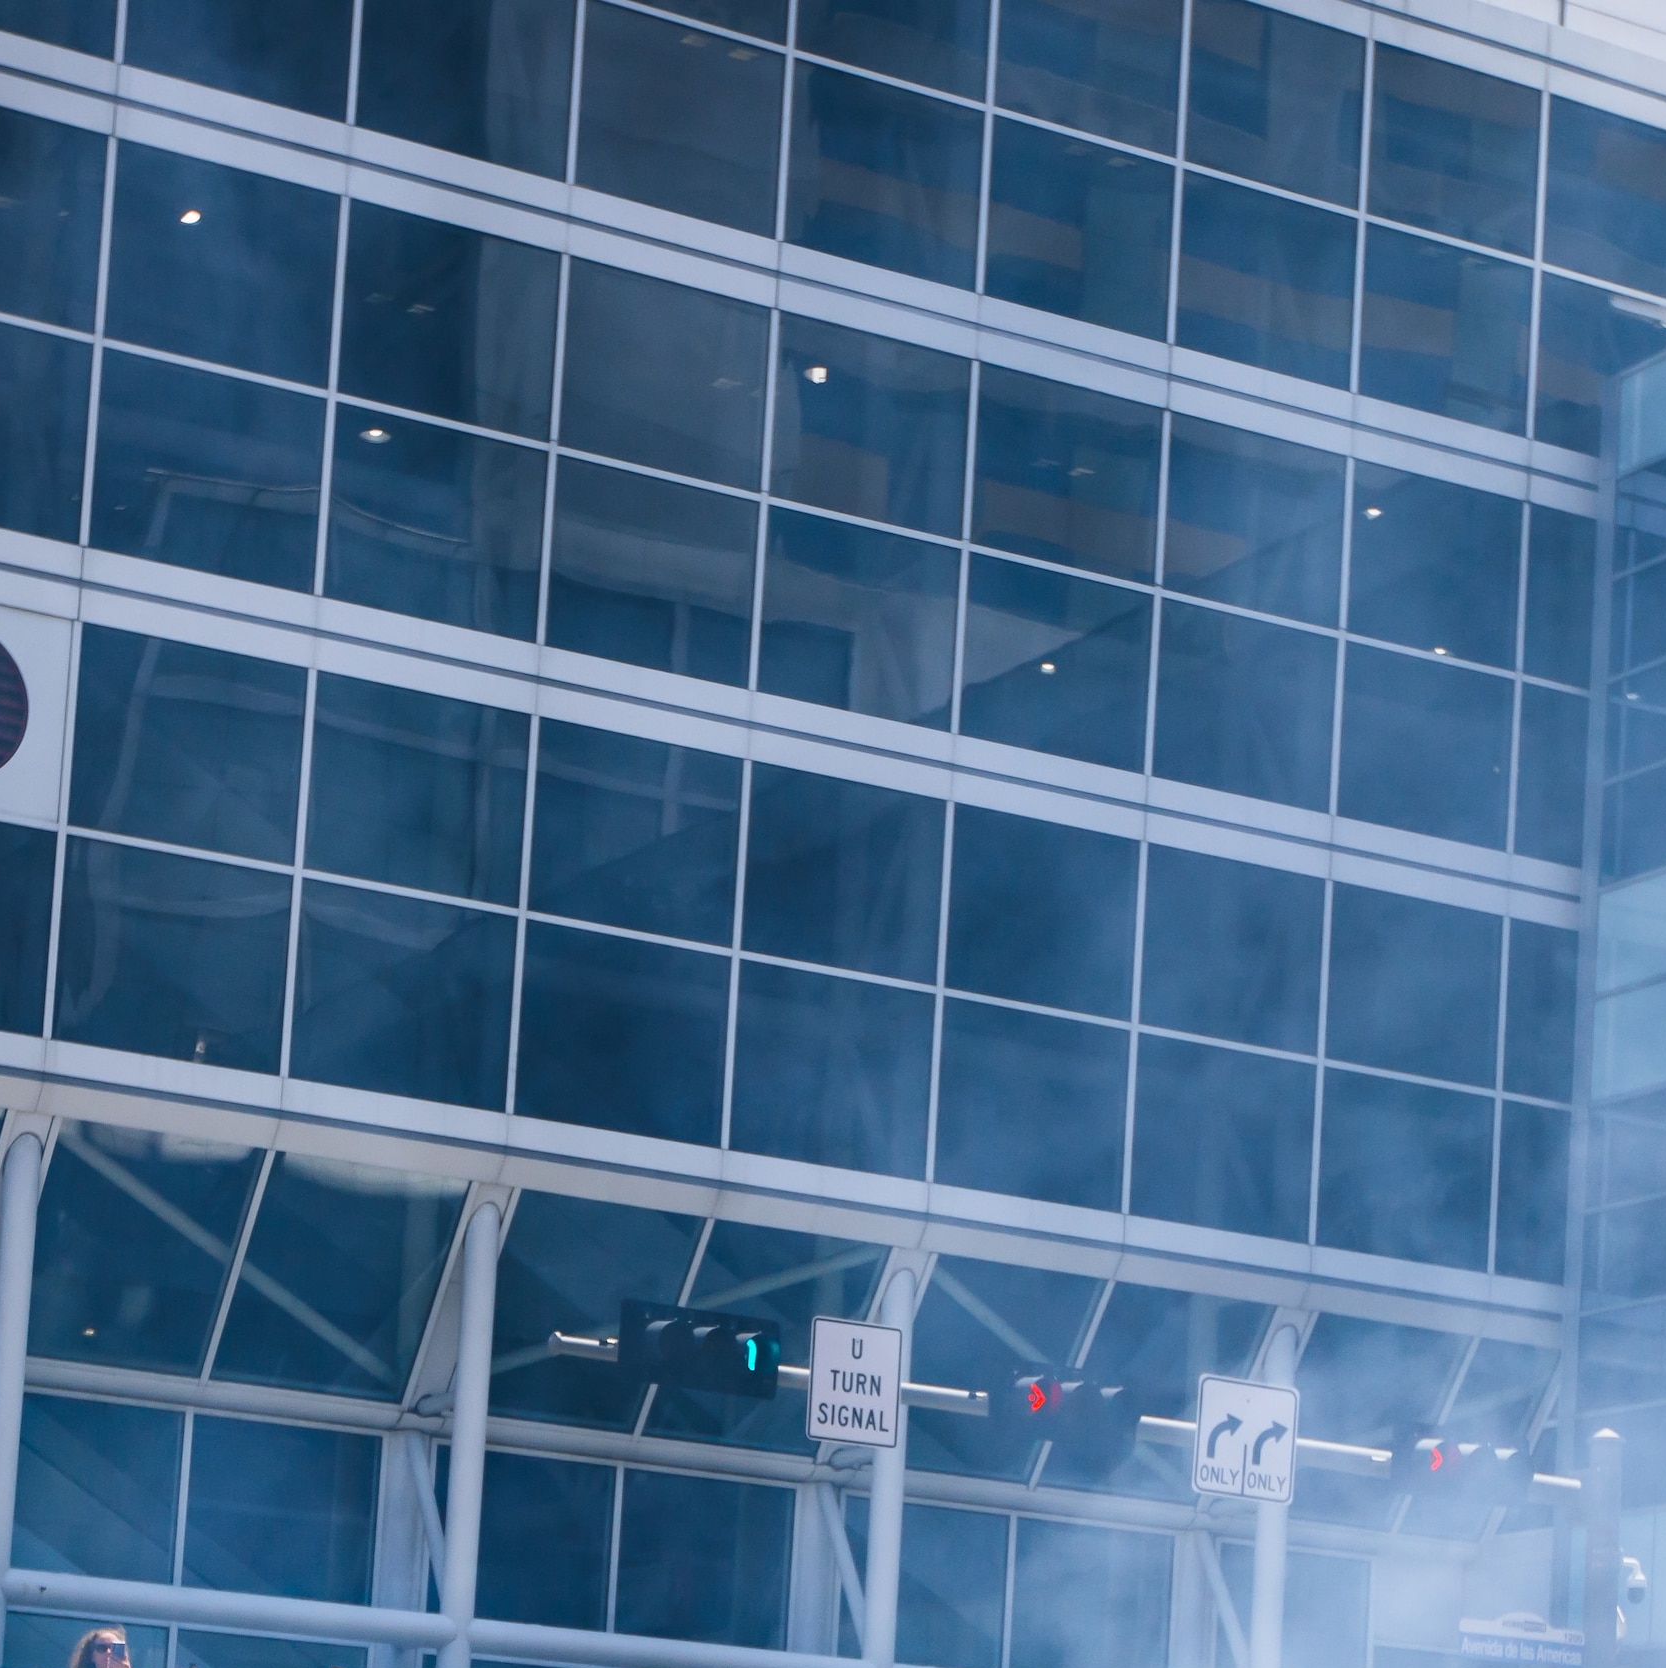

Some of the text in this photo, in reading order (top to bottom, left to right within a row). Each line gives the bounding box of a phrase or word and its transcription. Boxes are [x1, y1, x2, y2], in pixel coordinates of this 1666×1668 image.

[851, 1338, 863, 1360] U
[830, 1369, 882, 1398] TURN
[817, 1402, 889, 1433] SIGNAL
[1199, 1464, 1287, 1493] ONLY ONLY
[1461, 1636, 1503, 1658] Avenida
[1504, 1640, 1518, 1660] de
[1519, 1642, 1535, 1661] las
